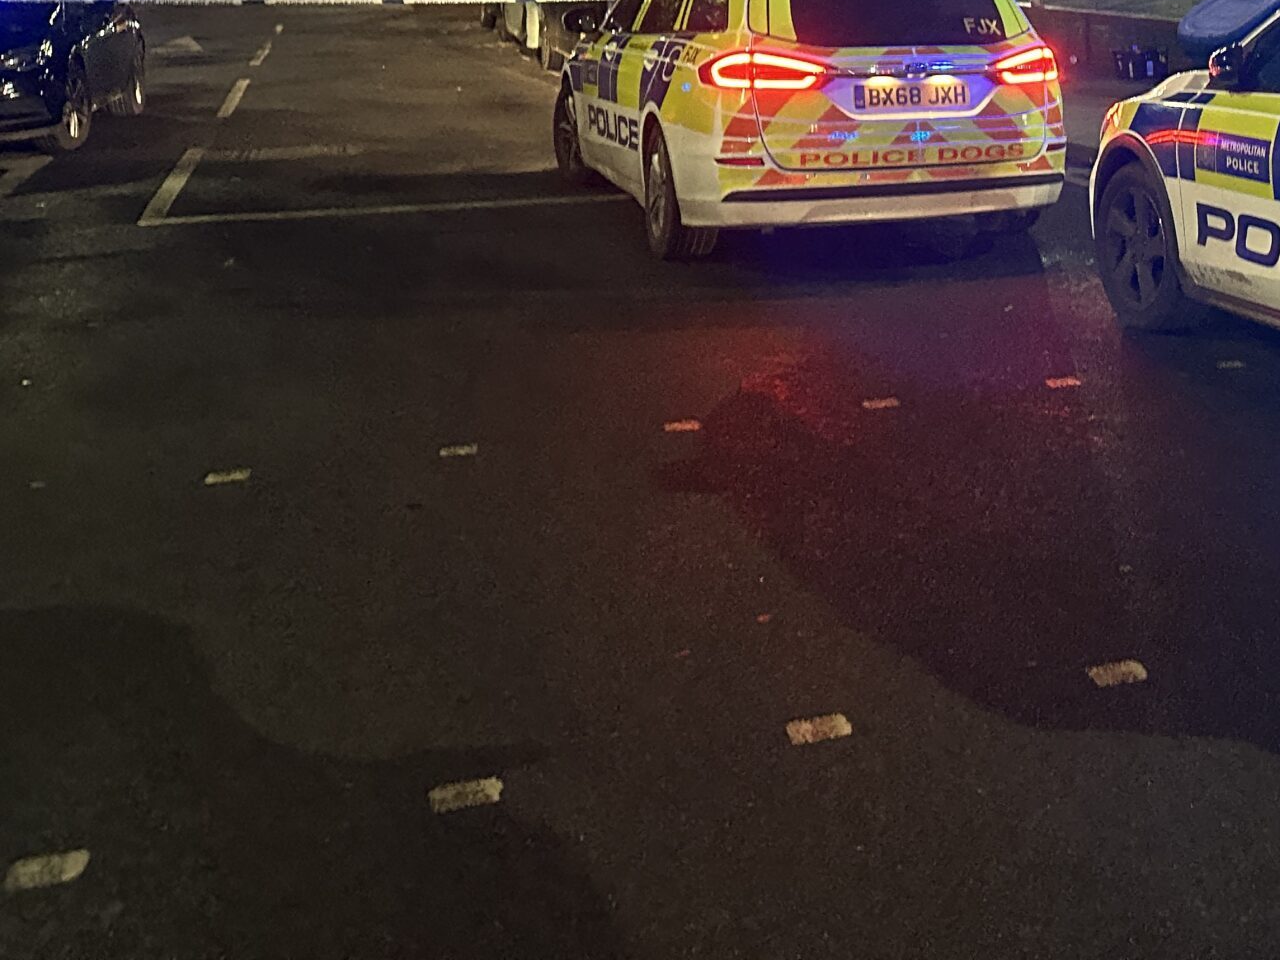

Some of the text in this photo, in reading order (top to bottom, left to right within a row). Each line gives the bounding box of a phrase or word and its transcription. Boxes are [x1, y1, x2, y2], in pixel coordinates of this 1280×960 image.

[963, 17, 1001, 36] FJX
[868, 85, 966, 106] BX68 JXH
[587, 103, 639, 151] POLICE
[800, 142, 1024, 166] POLICE DOGS
[1220, 138, 1267, 158] METROPOLITAN
[1226, 155, 1260, 175] POLICE
